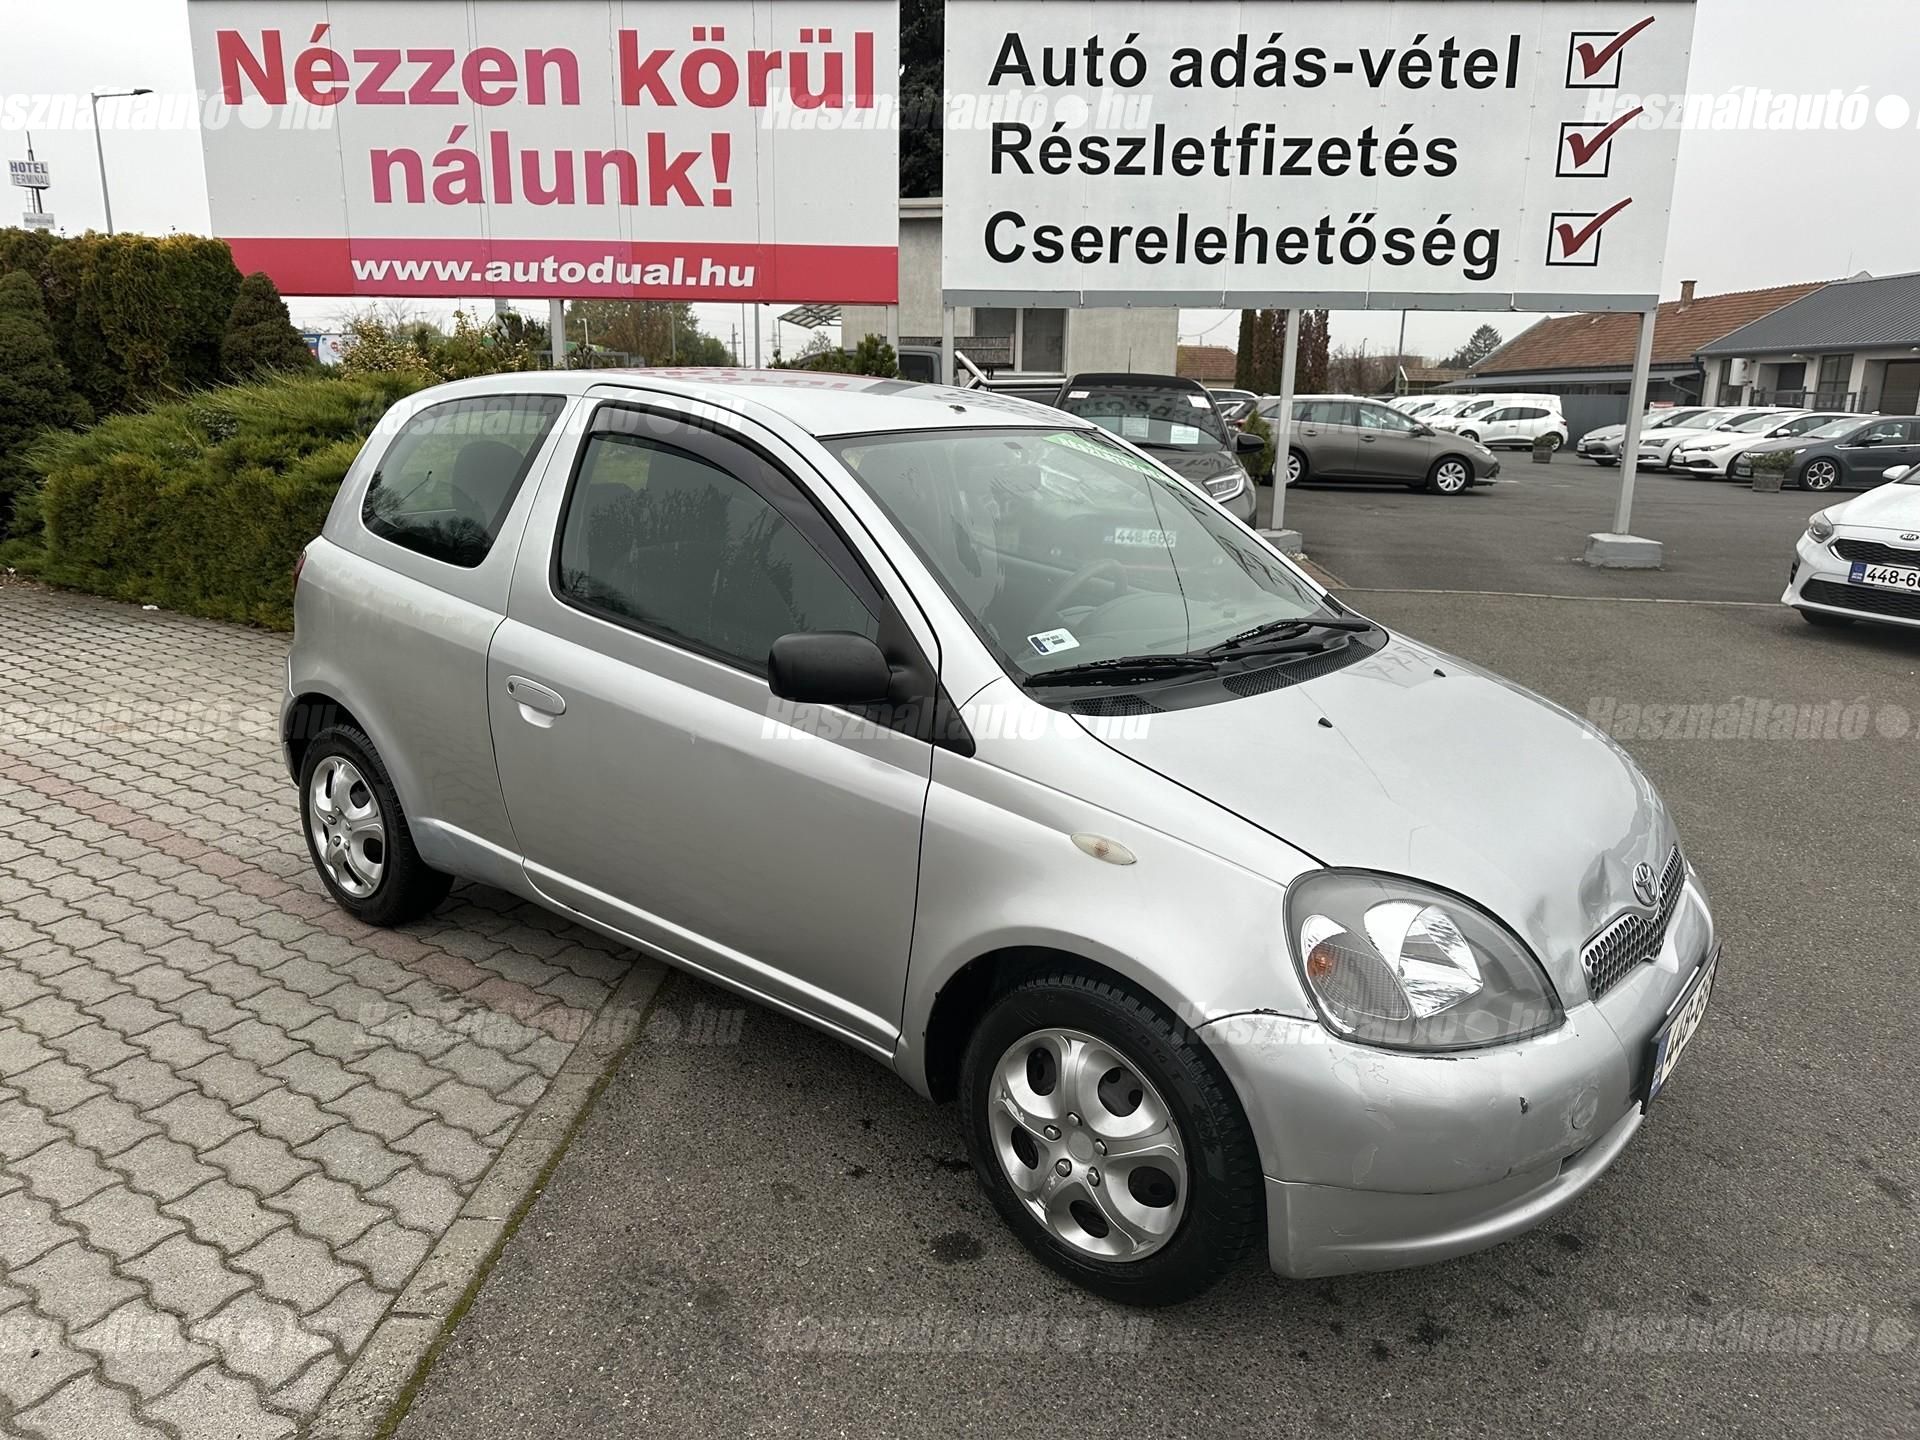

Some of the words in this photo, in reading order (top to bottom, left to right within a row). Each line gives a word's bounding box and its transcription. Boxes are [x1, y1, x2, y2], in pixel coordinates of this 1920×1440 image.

[216, 23, 580, 106] Nézzen
[619, 26, 875, 109] körül
[988, 32, 1148, 88] Autó
[1169, 33, 1521, 90] adás-vétel
[10, 161, 48, 173] HOTEL
[370, 124, 733, 208] nálunk!
[991, 121, 1459, 178] Részletfizetés
[11, 174, 49, 185] TERMINAL
[985, 210, 1501, 281] Cserelehetőség
[351, 255, 756, 289] www.autodual.hu
[1901, 533, 1918, 541] KIA
[1866, 567, 1920, 588] 448-6
